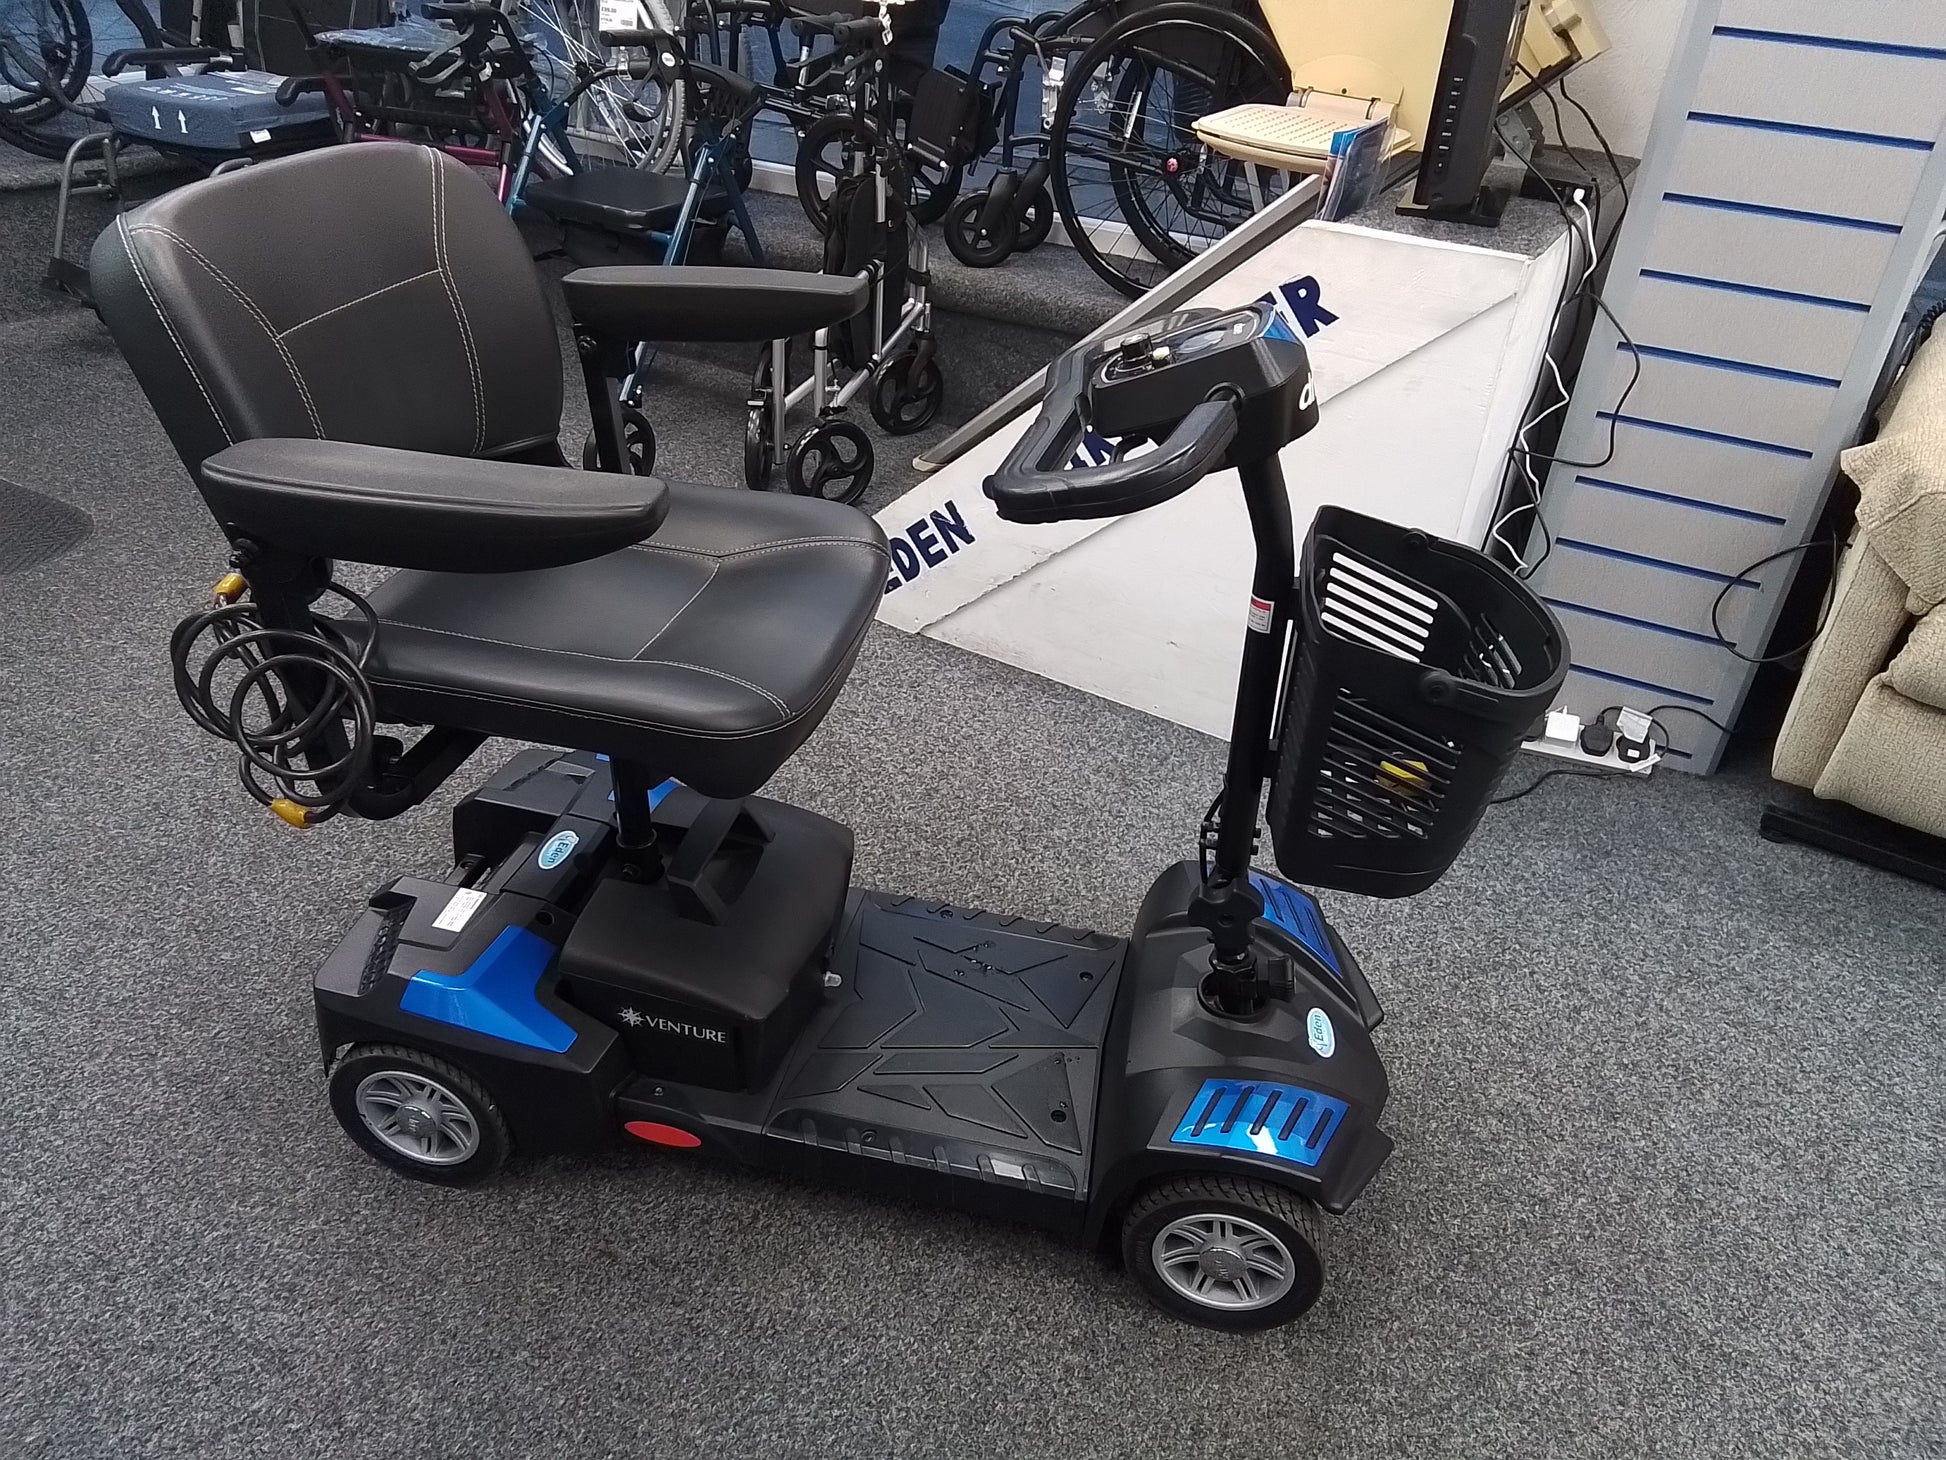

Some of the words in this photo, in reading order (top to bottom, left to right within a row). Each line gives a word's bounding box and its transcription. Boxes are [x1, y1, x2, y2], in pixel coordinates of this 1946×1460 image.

[884, 499, 976, 595] DEN
[547, 841, 570, 864] Eden
[645, 1015, 727, 1043] VENTURE
[1313, 1014, 1325, 1042] Eden
